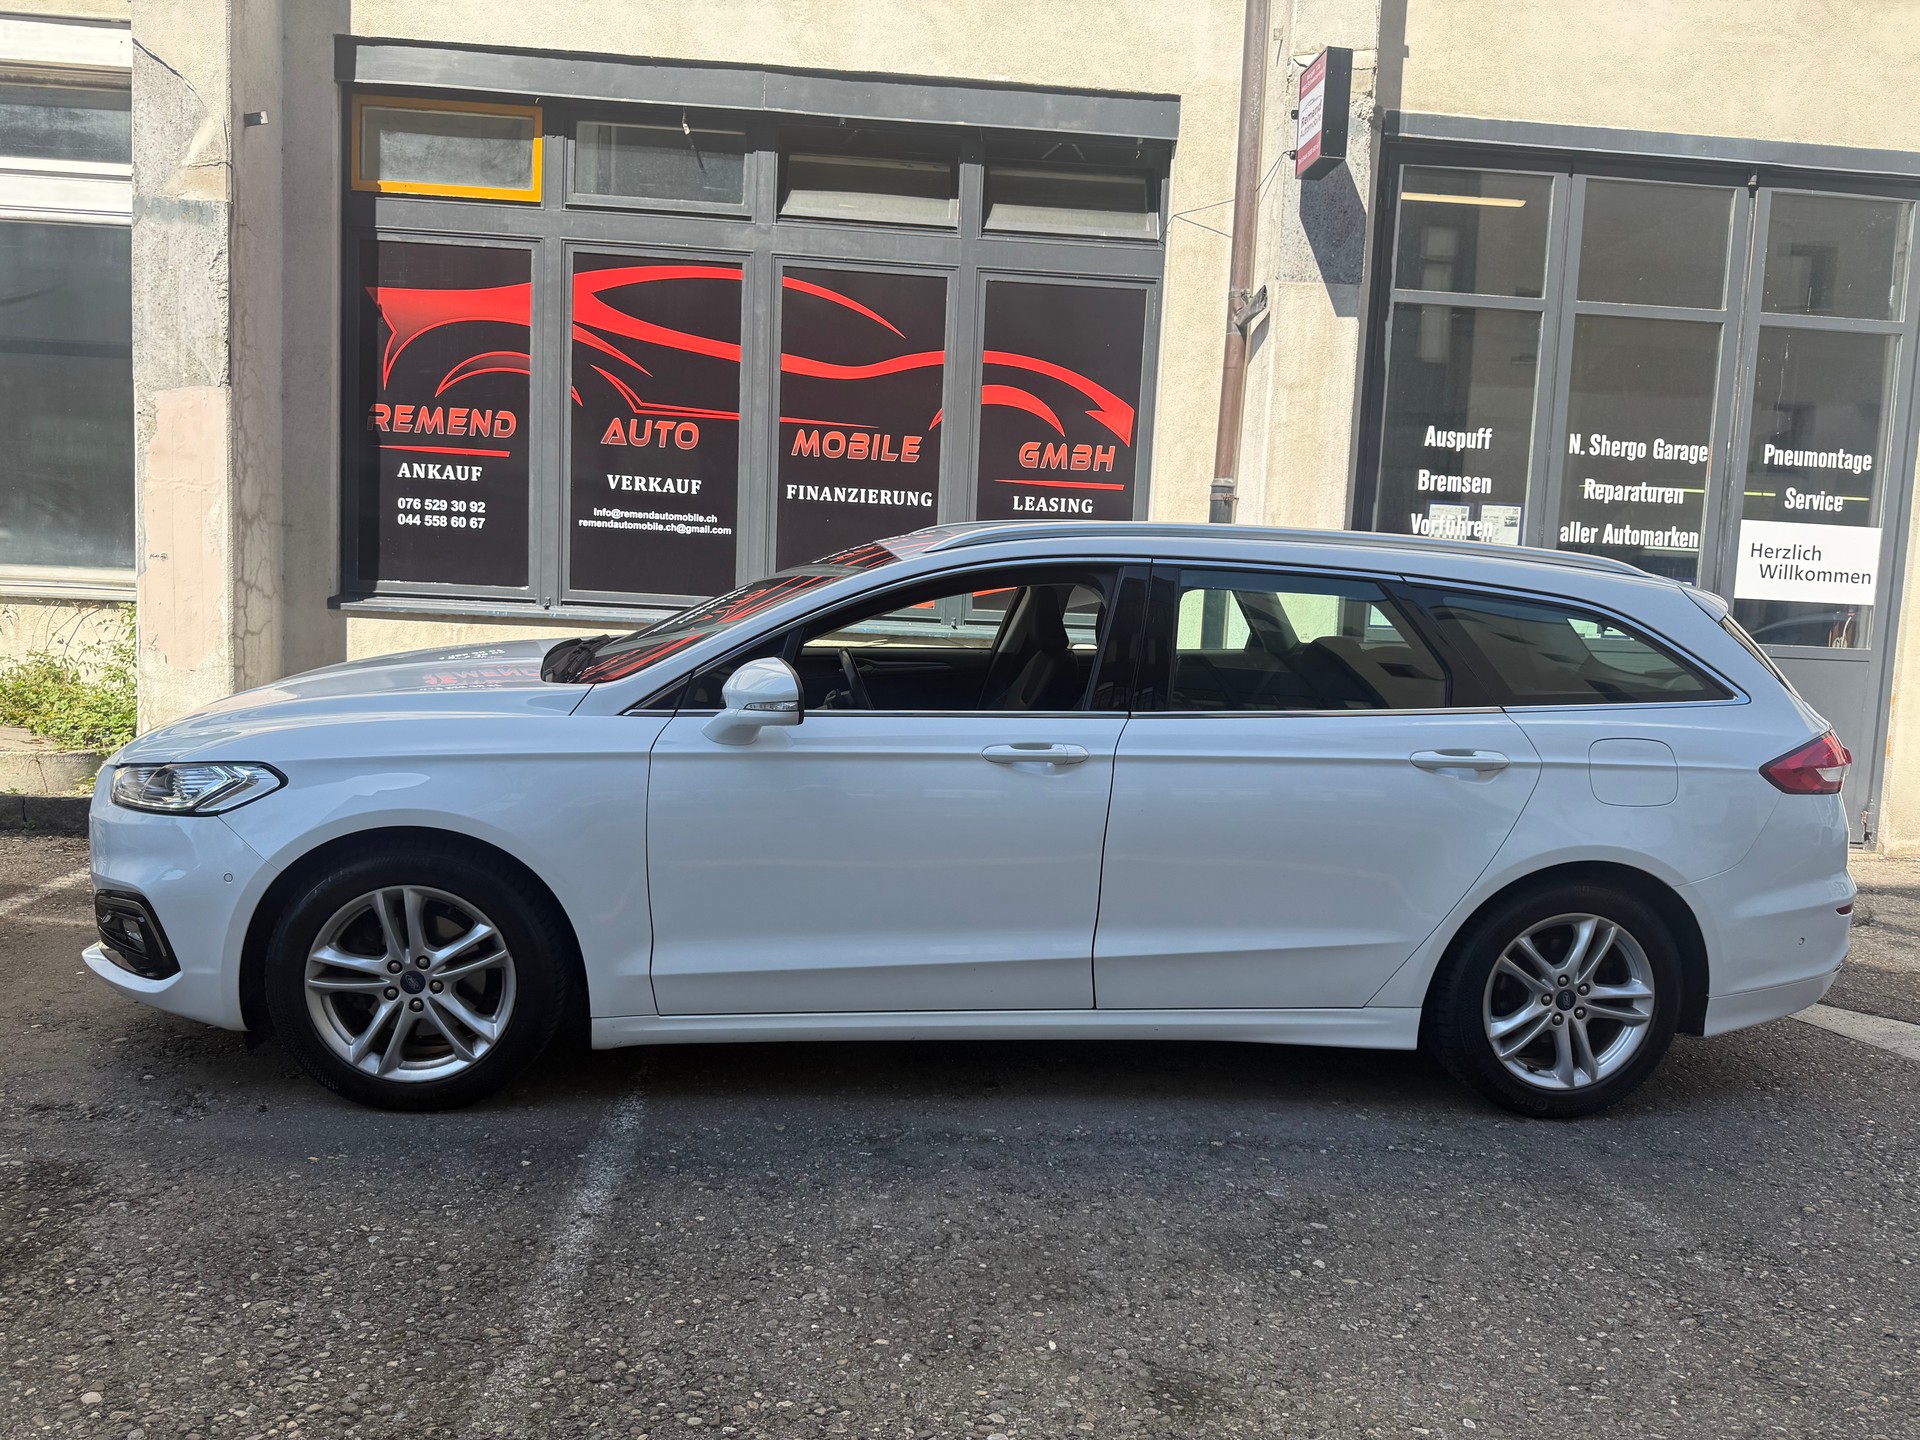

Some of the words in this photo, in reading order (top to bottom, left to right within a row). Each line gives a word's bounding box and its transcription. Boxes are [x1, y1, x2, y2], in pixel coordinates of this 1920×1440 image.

[367, 403, 517, 438] REMEND
[601, 417, 700, 450] AUTO
[791, 429, 922, 463] MOBILE
[1423, 425, 1493, 452] Auspuff
[1018, 441, 1116, 472] GMBH
[1568, 433, 1586, 456] N.
[1588, 433, 1647, 462] Shergo
[1652, 438, 1708, 465] Garage
[1763, 443, 1873, 475] Pneumontage
[396, 462, 483, 482] ANKAUF
[606, 474, 702, 495] VERKAUF
[1417, 469, 1492, 494] Bremsen
[786, 484, 933, 507] FINANZIERUNG
[1583, 478, 1684, 504] Reparaturen
[1785, 487, 1843, 512] Service
[397, 497, 422, 510] 076
[424, 498, 448, 511] 529
[450, 499, 467, 513] 30
[469, 500, 486, 514] 92
[1012, 495, 1094, 514] LEASING
[397, 513, 422, 526] 044
[424, 514, 448, 527] 558
[450, 515, 467, 529] 60
[469, 516, 486, 529] 67
[578, 519, 732, 535] remendautomobile.ch@gmail.com
[1559, 520, 1599, 544] aller
[1602, 523, 1699, 548] Automarken
[1750, 542, 1822, 562] Herzlich
[1759, 563, 1871, 585] Willkommen
